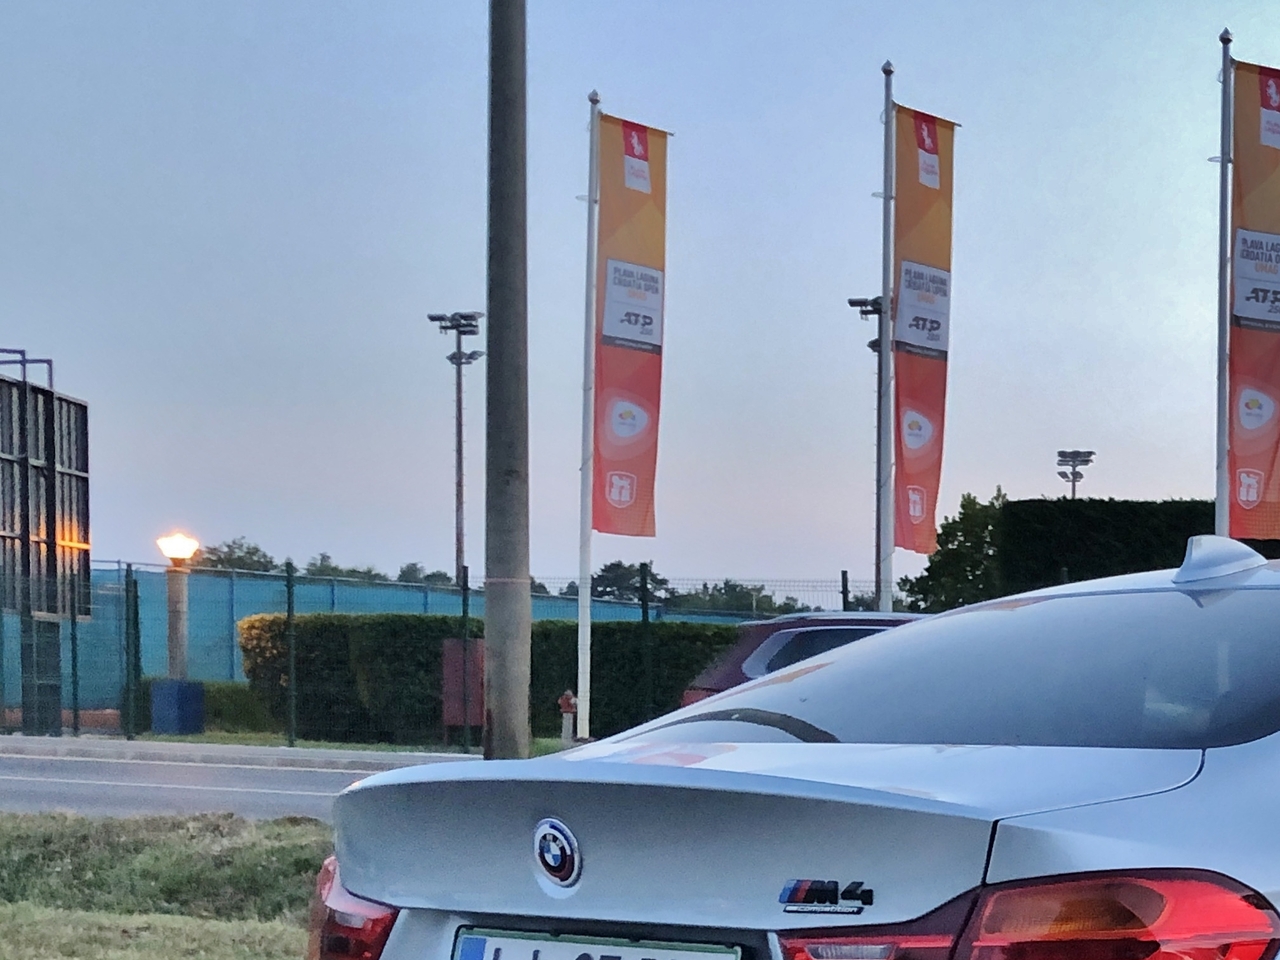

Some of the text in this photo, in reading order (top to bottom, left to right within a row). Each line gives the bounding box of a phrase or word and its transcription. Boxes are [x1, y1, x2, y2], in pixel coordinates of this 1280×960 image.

[1242, 238, 1264, 250] PLAVA
[1241, 249, 1272, 263] CROATIA
[1255, 262, 1278, 274] UMAG
[620, 311, 653, 326] ATP
[908, 316, 941, 331] ATP
